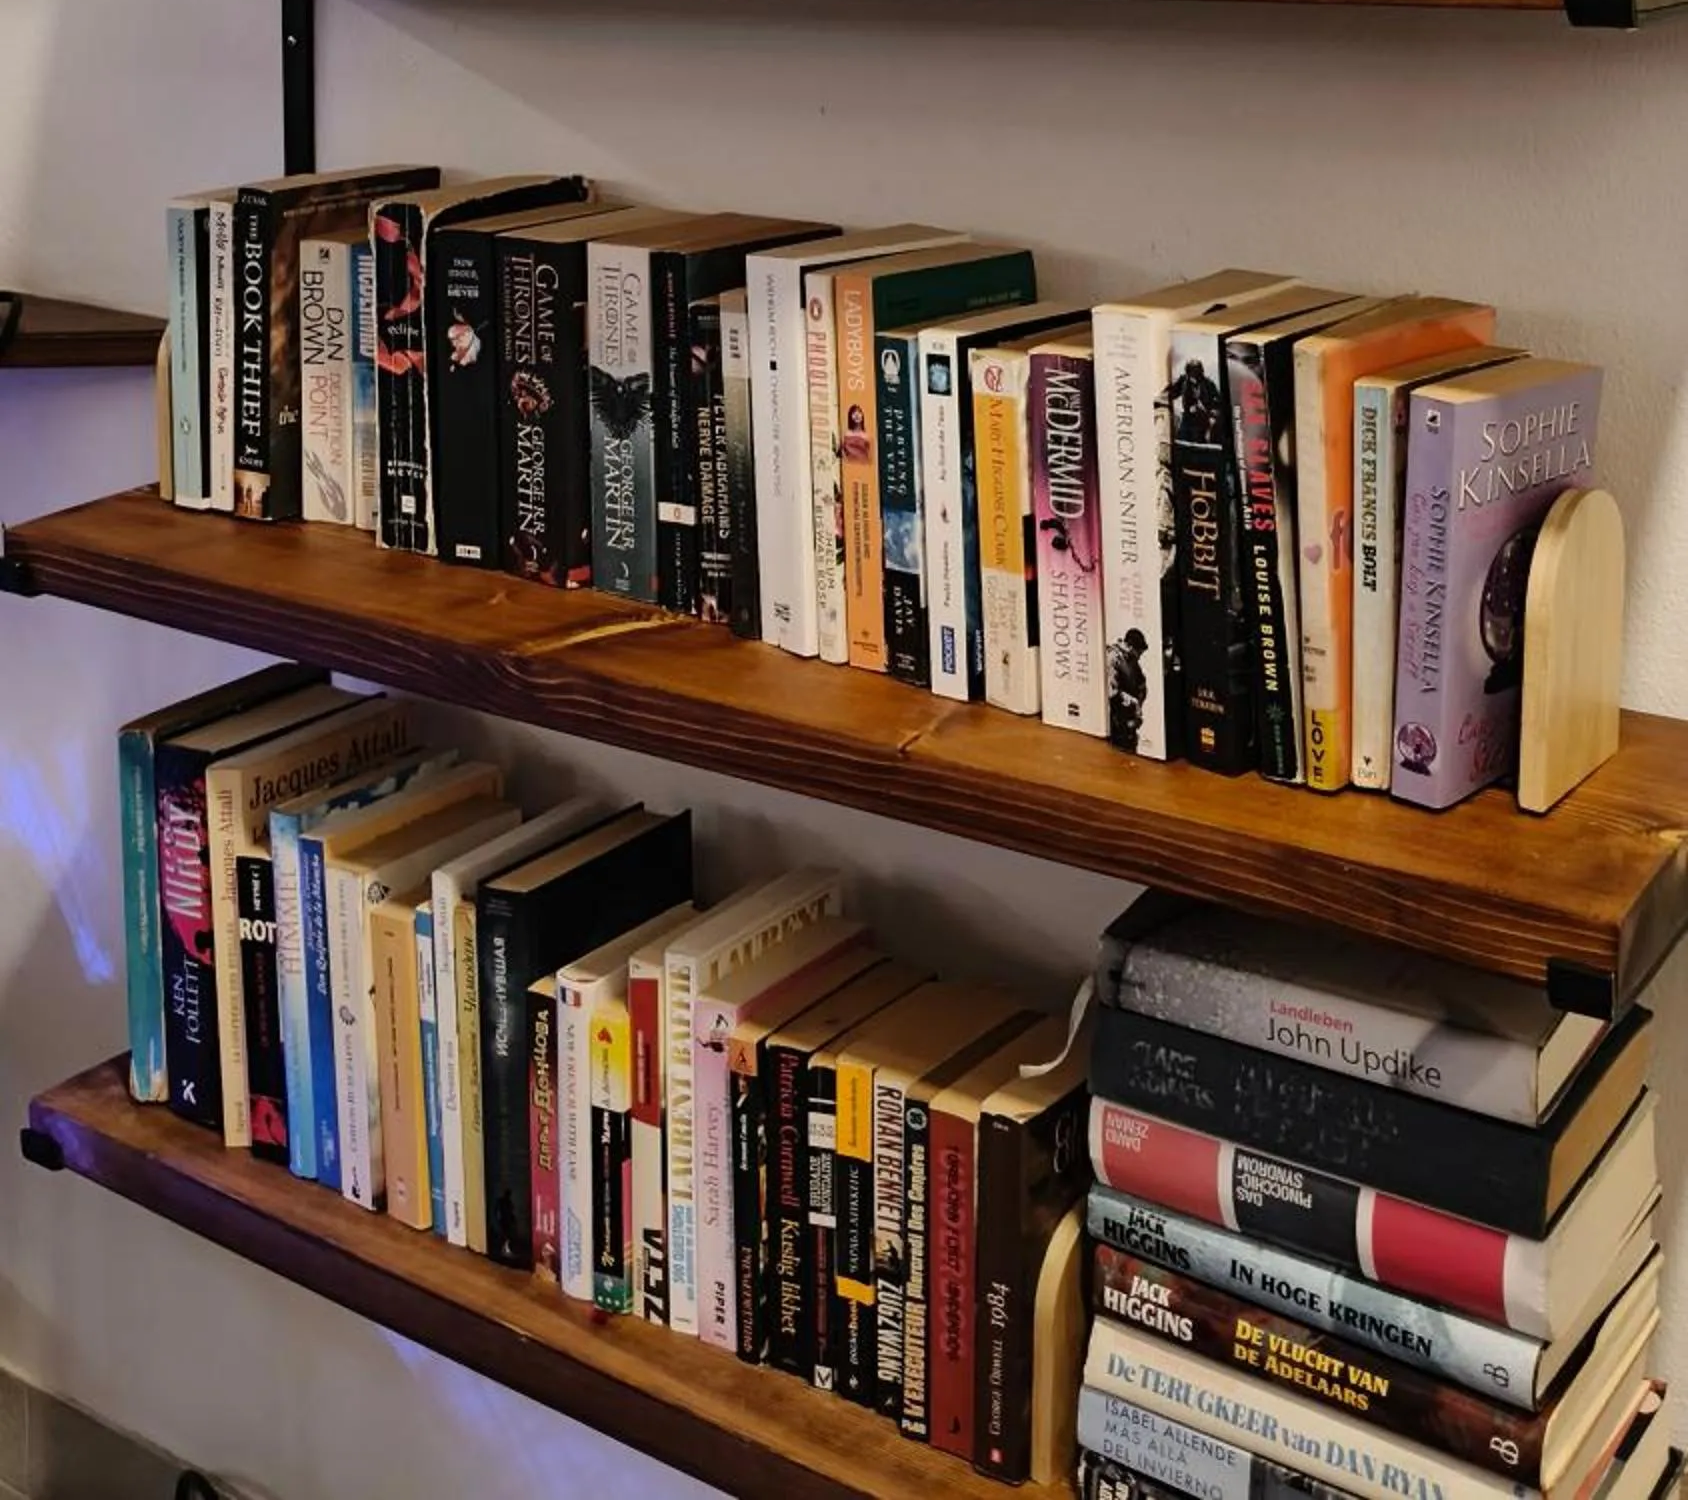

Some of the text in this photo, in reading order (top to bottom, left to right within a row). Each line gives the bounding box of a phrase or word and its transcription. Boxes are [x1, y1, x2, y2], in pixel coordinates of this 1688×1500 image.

[242, 240, 262, 331] BOOK
[303, 271, 328, 365] BROWN
[511, 254, 533, 364] THRONES
[603, 264, 622, 366] THRONES
[326, 306, 344, 361] DAN
[844, 288, 864, 391] LADYBOYS
[242, 340, 261, 436] THIEF
[309, 375, 329, 441] POINT
[329, 372, 341, 465] DECEPTION
[1481, 401, 1580, 462] SOPHIE
[517, 424, 532, 535] MARTIN
[604, 436, 622, 550] MARTIN
[697, 407, 714, 524] NERVE DAMAGE
[883, 405, 896, 494] THE VEIL
[990, 398, 1009, 569] MARY HIGGINS CLARK
[1113, 366, 1139, 564] AMERICAN SNIPER
[1458, 439, 1593, 511] KINSELLA
[1183, 469, 1221, 602] HOBBIT
[1361, 407, 1378, 592] DICK FRANCIS BOLT
[893, 585, 904, 635] DAVIS
[903, 594, 915, 629] JAY
[1050, 571, 1072, 679] SHADOWS
[1073, 573, 1089, 683] KILLING THE
[1253, 545, 1278, 692] LOUISE BROWN
[1418, 485, 1450, 694] SOPHIE KINSELLA
[172, 974, 185, 1015] KEN
[184, 953, 199, 1043] FOLLETT
[463, 936, 477, 1013] Чемодан
[1269, 1000, 1353, 1033] Landleben
[1266, 1017, 1442, 1089] John Updike
[701, 1102, 721, 1227] Sarah Harvey
[778, 1053, 799, 1207] Patricia Cornwell
[877, 1085, 904, 1236] RONAN BENNETT
[1237, 1156, 1303, 1187] SYNDROM
[809, 1156, 820, 1207] BRIGADE
[821, 1154, 832, 1213] MONDAINE
[777, 1218, 800, 1333] Kuslig likhet
[1102, 1218, 1191, 1270] HIGGINS
[714, 1280, 726, 1324] PIPER
[877, 1279, 904, 1382] ZUGZWANG
[987, 1282, 1010, 1328] 1984
[1102, 1286, 1193, 1343] HIGGINS
[1129, 1275, 1170, 1308] JACK
[1229, 1260, 1433, 1358] IN HOGE KRINGEN
[989, 1339, 1004, 1435] GEORGE ORWELL
[1232, 1345, 1369, 1410] DE ADELAARS
[1234, 1319, 1390, 1397] DE VLUCHT VAN
[1103, 1397, 1237, 1466] ISABEL ALLENDE
